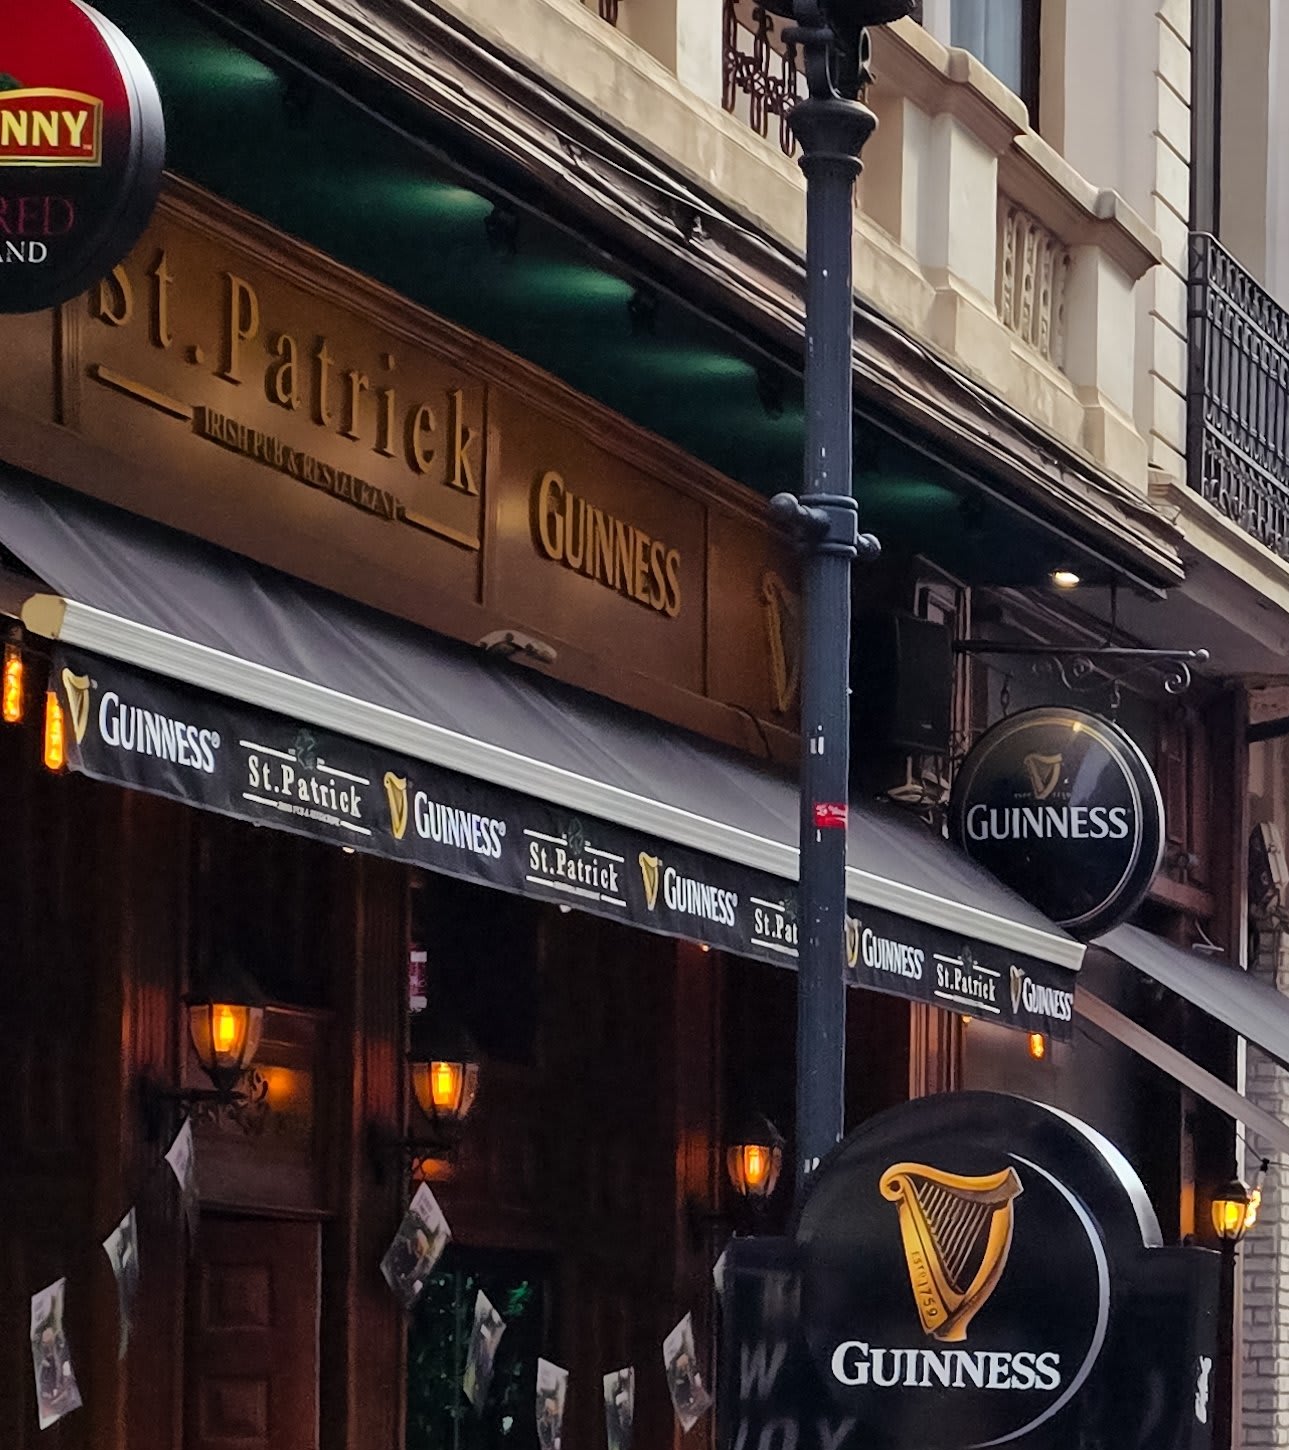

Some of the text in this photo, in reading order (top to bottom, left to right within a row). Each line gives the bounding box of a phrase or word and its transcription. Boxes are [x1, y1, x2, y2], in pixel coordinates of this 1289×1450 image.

[538, 470, 682, 618] GUINNESS
[99, 691, 216, 774] GUINNESS
[414, 791, 503, 859] GUINNESS
[663, 866, 736, 927] GUINNESS
[967, 804, 1129, 841] GUINNESS
[861, 927, 923, 980] GUINNESS
[831, 1340, 1061, 1390] GUINNESS
